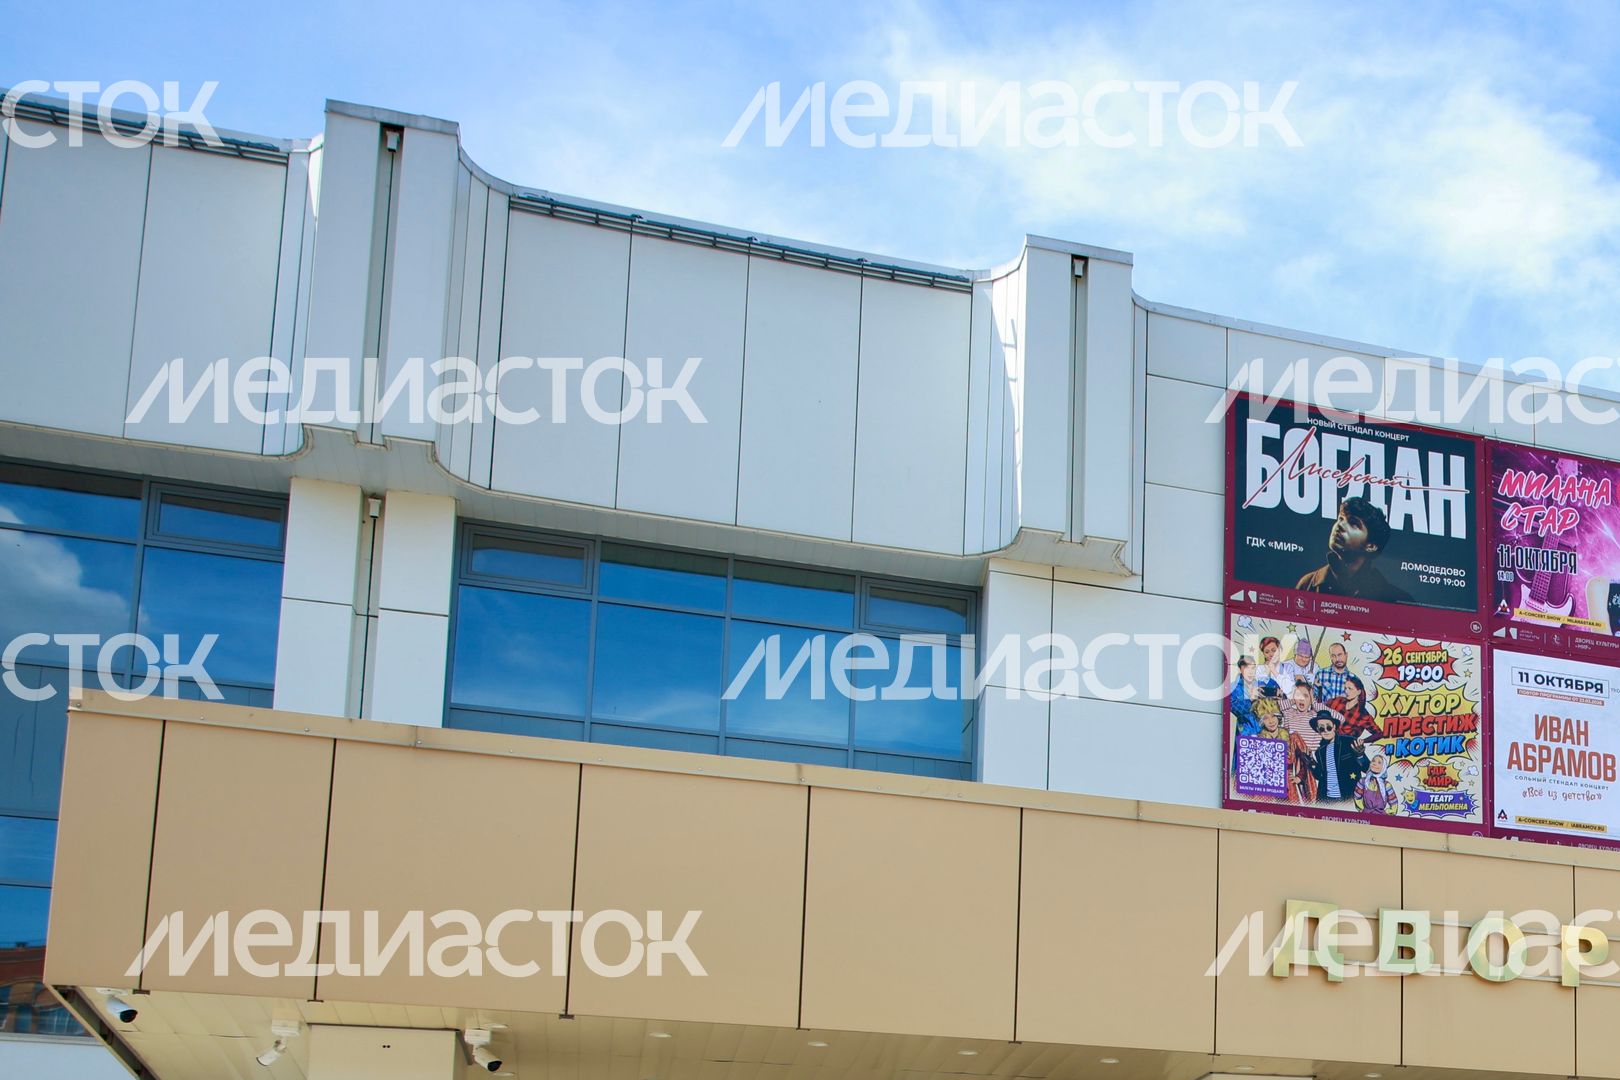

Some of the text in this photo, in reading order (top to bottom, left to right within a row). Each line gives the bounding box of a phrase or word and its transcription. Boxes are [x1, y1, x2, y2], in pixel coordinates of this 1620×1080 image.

[1307, 417, 1410, 442] НОВЫЙ СТЕНДАП КОНЦЕРТ
[1246, 418, 1467, 540] БОГДАН
[1498, 468, 1611, 509] МИЛАНА
[1500, 501, 1580, 537] СТАР
[1246, 536, 1304, 553] ГДК «МИР»
[1400, 561, 1466, 577] ДОМОДЕДОВО
[1496, 543, 1578, 574] 11 ОКТЯБРЯ
[1419, 574, 1466, 588] 12.09 19:00
[1383, 648, 1447, 665] 26 СЕНТЯБРЯ
[1397, 665, 1444, 682] 19:00
[1518, 671, 1530, 684] 11
[1534, 674, 1604, 694] ОКТЯБРЯ
[1379, 693, 1461, 716] ХУТОР
[1382, 713, 1478, 738] ПРЕСТИЖ
[1534, 714, 1589, 747] ИВАН
[1395, 736, 1466, 757] КОТИК
[1507, 741, 1616, 782] АБРАМОВ
[1514, 775, 1609, 791] СОЛЬНЫЙ СТЕНДАП КОНЦЕРТ
[1418, 801, 1469, 812] МЕЛЬПОМЕНА
[1429, 794, 1454, 803] ТЕАТР
